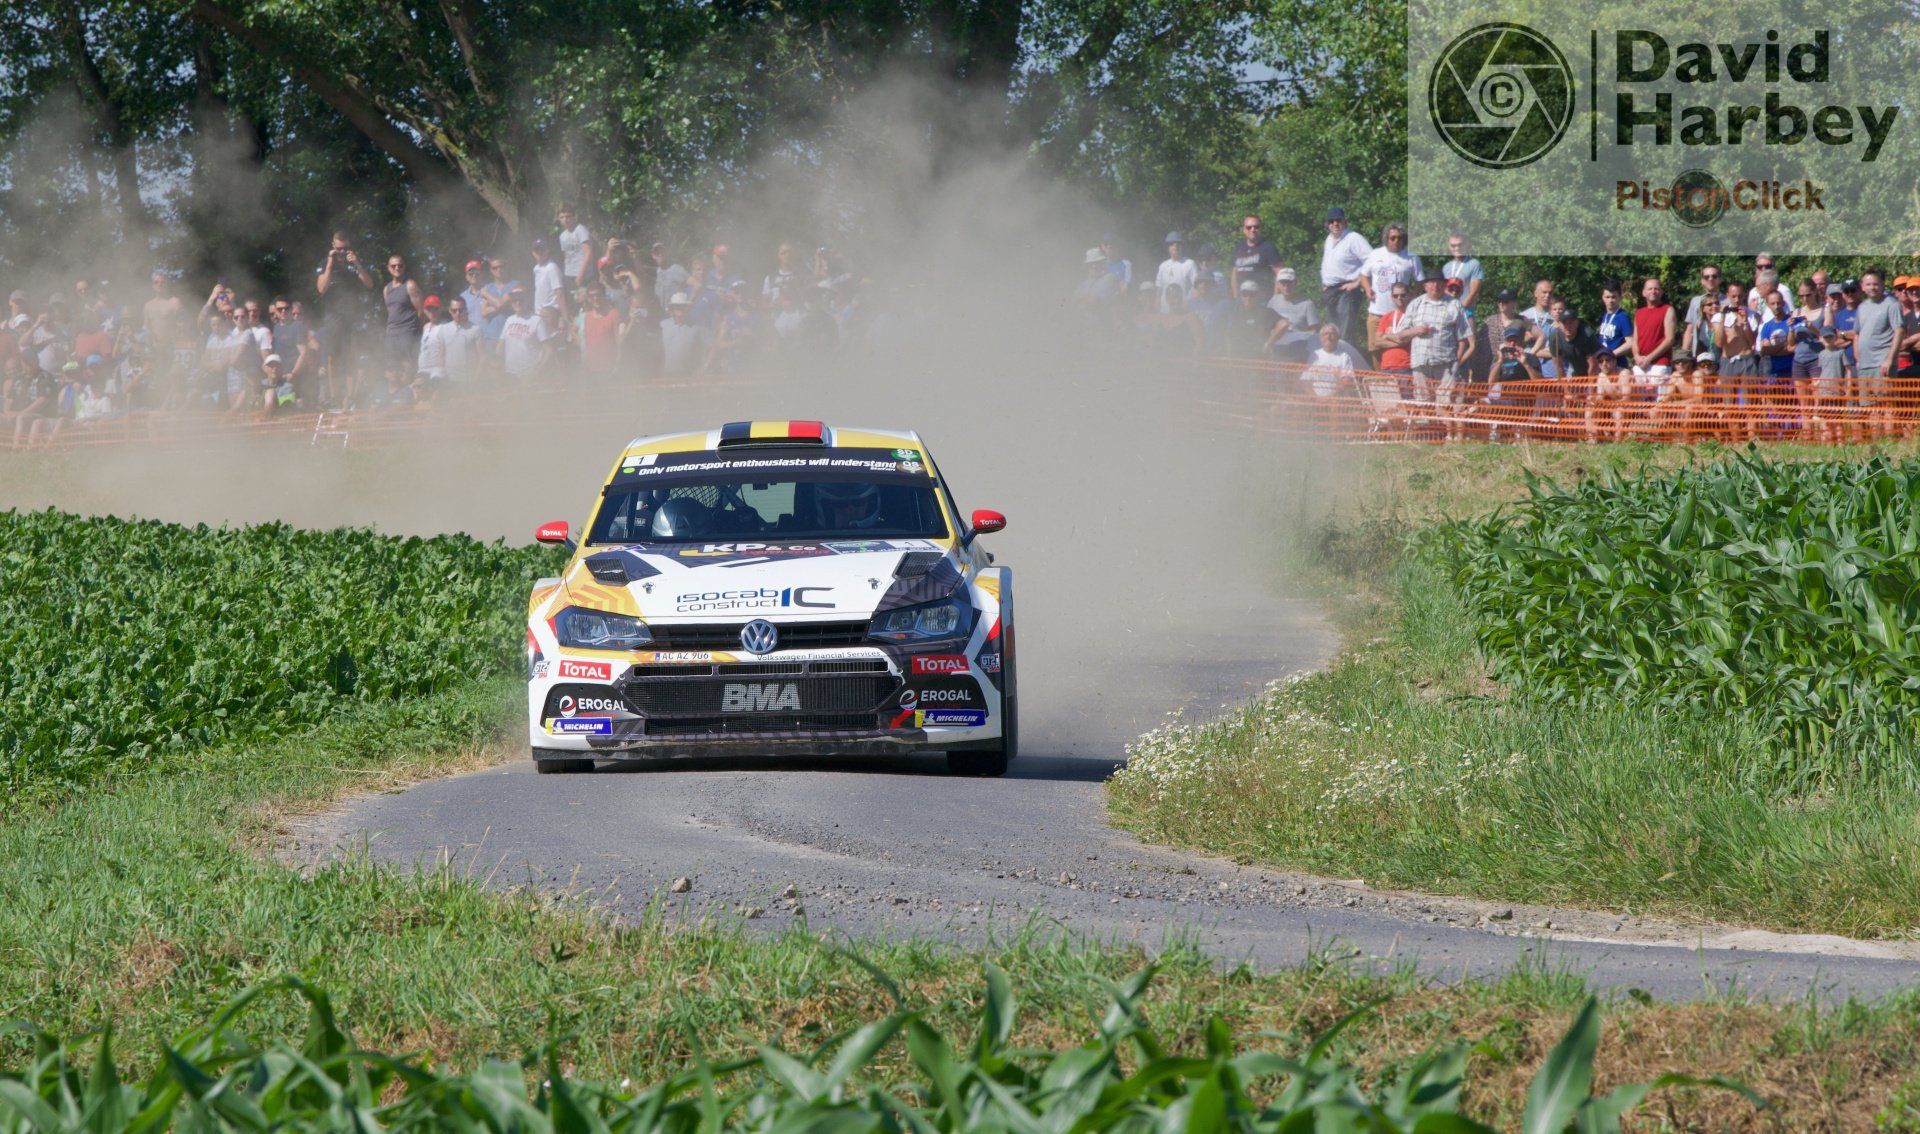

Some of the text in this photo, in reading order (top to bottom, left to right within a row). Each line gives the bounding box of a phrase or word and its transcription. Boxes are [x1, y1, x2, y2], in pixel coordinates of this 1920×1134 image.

[637, 456, 645, 465] 1
[638, 466, 665, 476] Only
[665, 460, 732, 473] motorsport
[808, 457, 829, 467] will
[830, 457, 897, 469] understand
[542, 529, 563, 537] TOTAL
[702, 542, 767, 553] KP
[676, 588, 778, 603] isocab
[676, 598, 777, 613] construct
[757, 650, 882, 662] Volkswagen Financial Services
[563, 661, 607, 679] TOTAL
[916, 657, 966, 671] TOTAL
[721, 682, 801, 712] BMA
[920, 689, 972, 702] EROGAL
[578, 697, 628, 711] EROGAL
[936, 715, 979, 723] MICHELIN
[564, 723, 604, 731] MICHELIN
